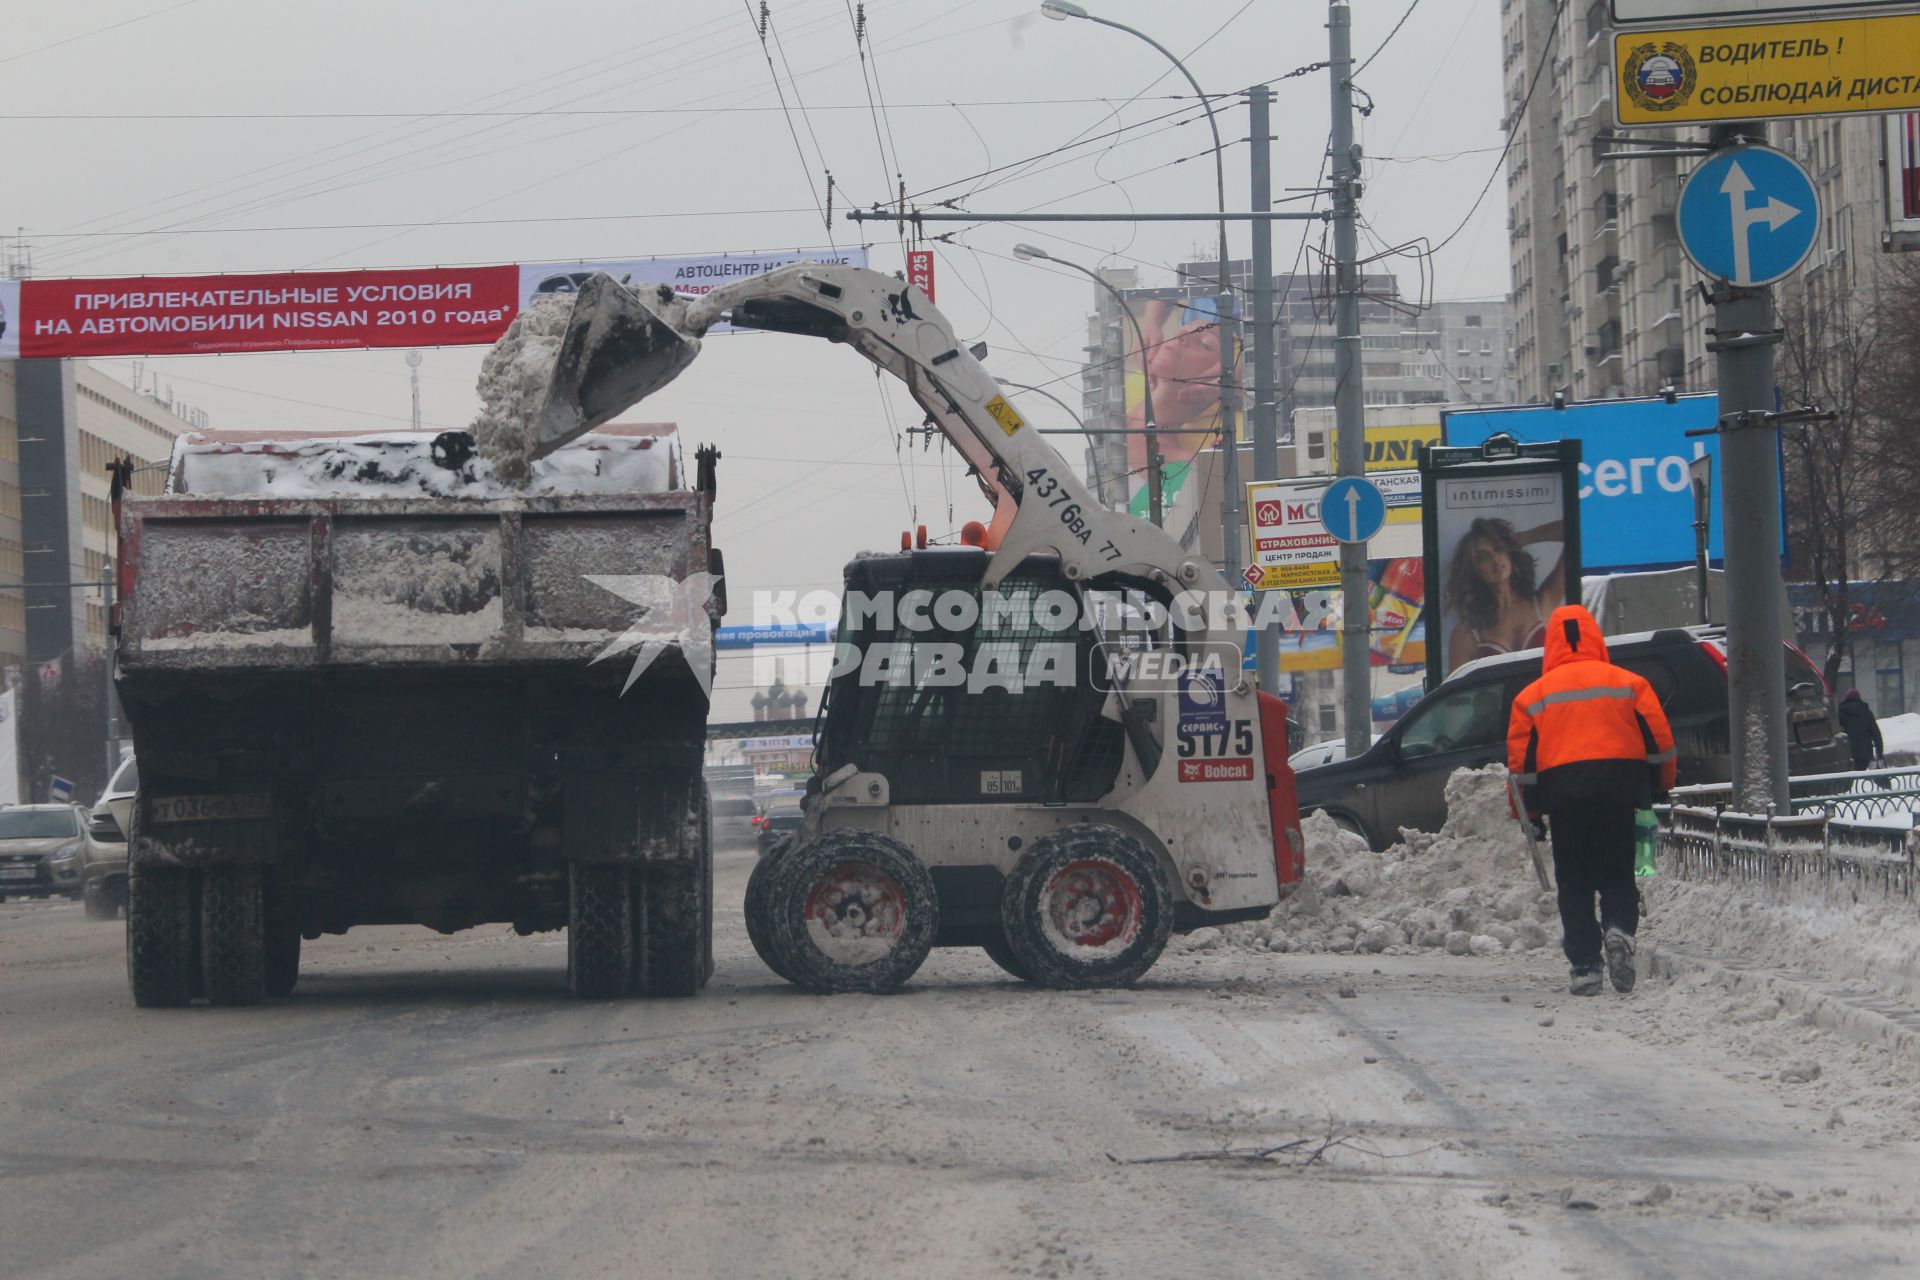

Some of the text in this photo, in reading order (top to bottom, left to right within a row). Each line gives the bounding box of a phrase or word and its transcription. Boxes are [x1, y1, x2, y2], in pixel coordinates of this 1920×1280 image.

[1699, 38, 1829, 66] ВОДИТЕЛЬ
[1700, 76, 1843, 105] СОБЛЮДАЙ
[675, 263, 760, 279] АВТОЦЕНТР
[75, 283, 472, 310] ПРИВЛЕКАТЕЛЬНЫЕ УСЛОВИЯ
[35, 318, 73, 336] НА
[79, 313, 264, 335] АВТОМОБИЛИ
[272, 309, 369, 329] NISSAN
[376, 309, 437, 326] 2010
[1374, 475, 1420, 486] ГАНСКАЯ
[1453, 486, 1549, 501] intimissimi
[1260, 537, 1337, 549] СТРАХОВАНИЕ
[1099, 540, 1122, 562] 77
[1265, 550, 1332, 562] ЦЕНТР ПРОДАЖ
[737, 629, 817, 642] провокация
[1181, 722, 1225, 733] СЕРВИС+
[1204, 764, 1248, 779] Bobcat
